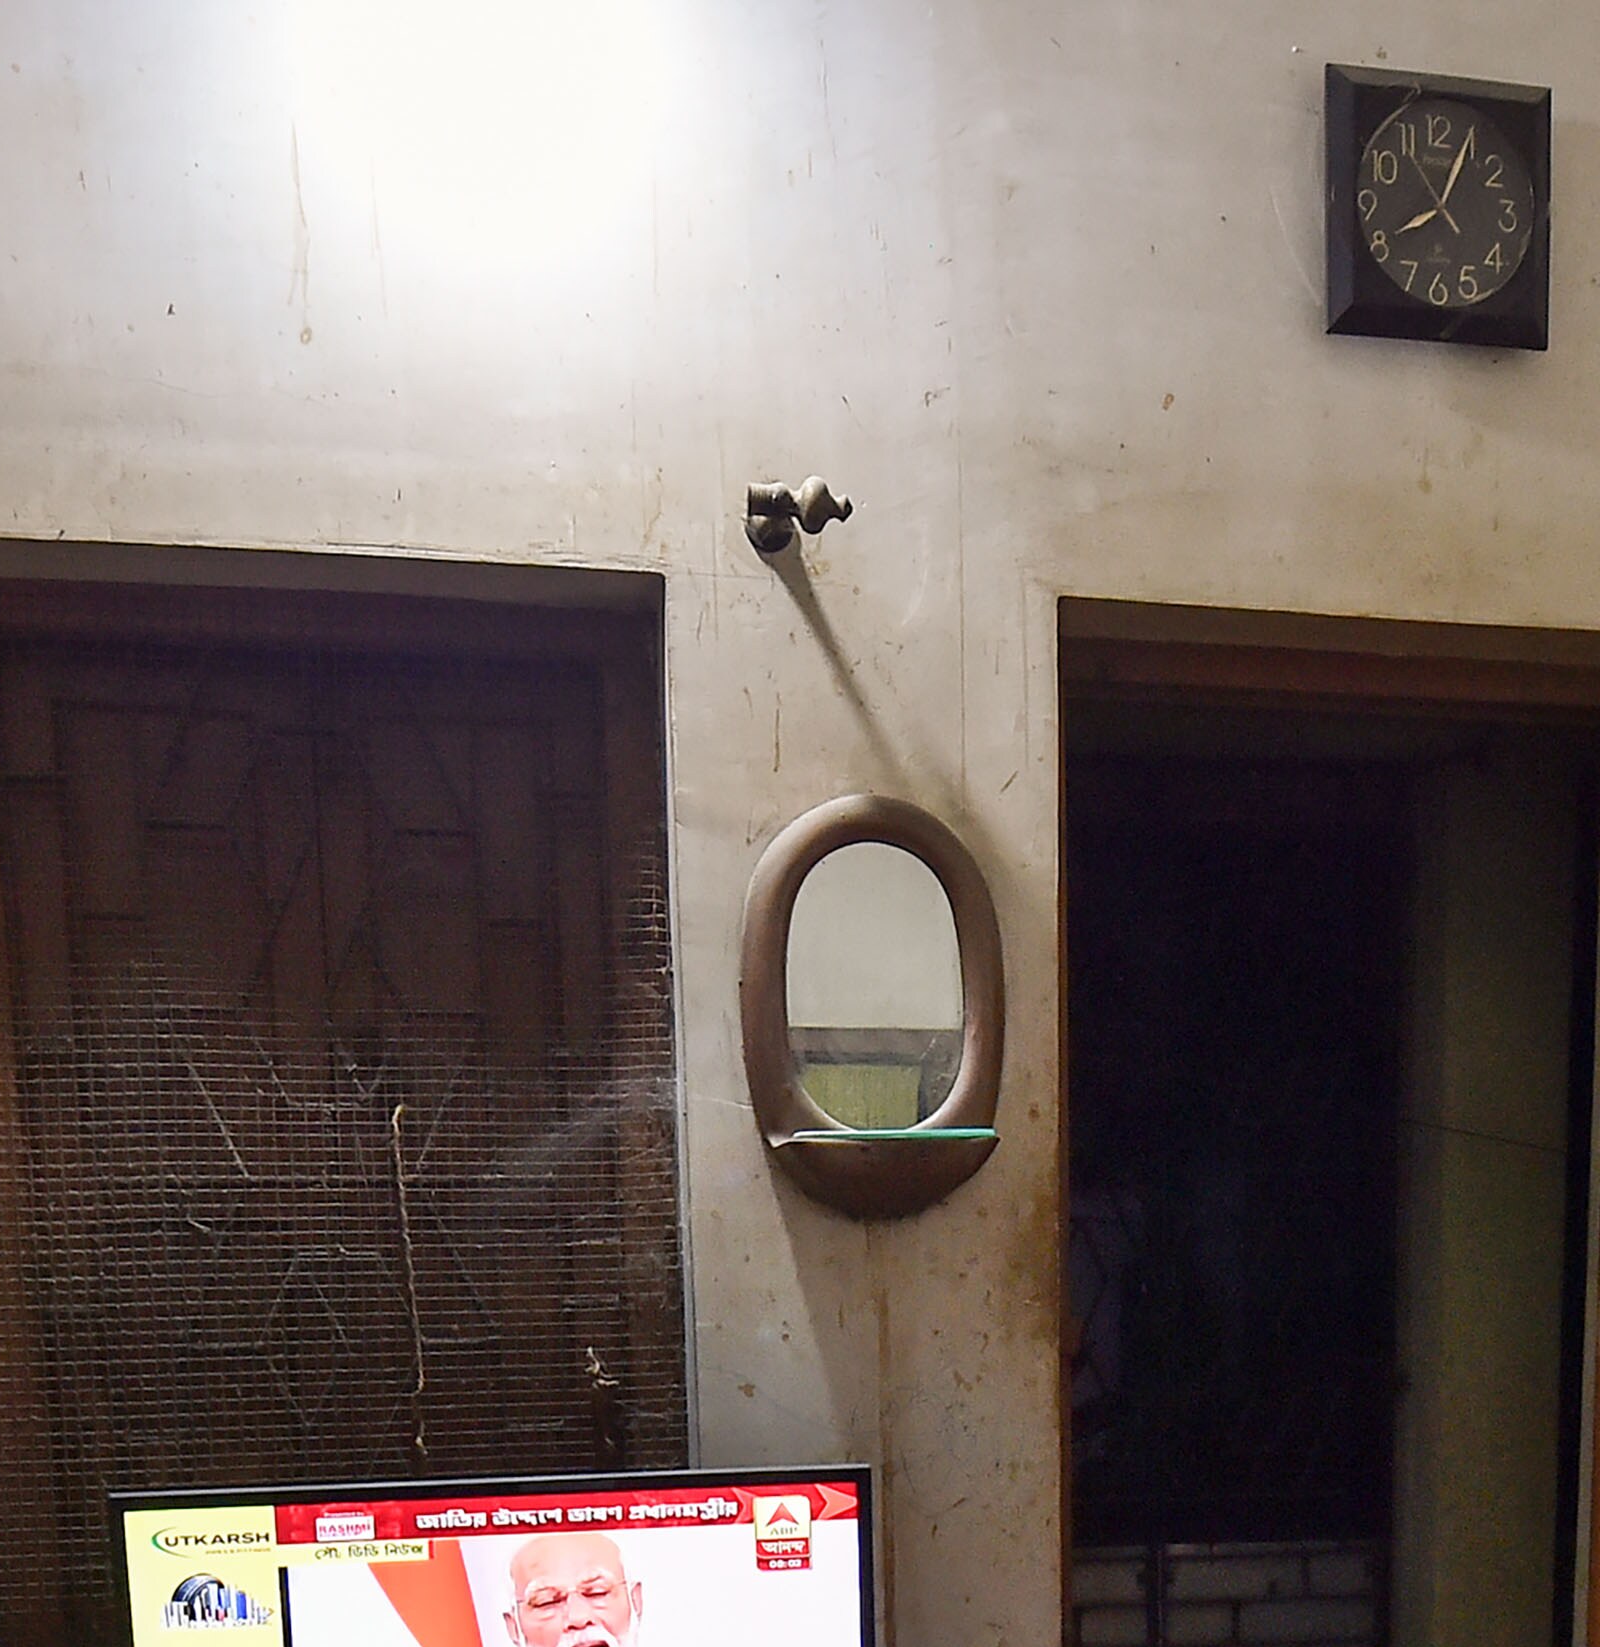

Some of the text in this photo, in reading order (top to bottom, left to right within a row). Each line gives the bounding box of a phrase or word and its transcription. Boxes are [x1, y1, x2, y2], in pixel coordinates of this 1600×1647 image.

[1395, 121, 1416, 157] 11
[1425, 114, 1451, 149] 12
[1372, 149, 1399, 185] 10
[1484, 154, 1504, 189] 2
[1357, 188, 1378, 221] 9
[1498, 199, 1518, 233] 3
[1370, 229, 1390, 263] 8
[1483, 242, 1502, 275] 4
[1400, 259, 1419, 292] 7
[1428, 272, 1449, 306] 6
[1457, 265, 1479, 299] 5
[415, 1508, 487, 1529] জাতির
[567, 1505, 623, 1523] ভাষণ
[164, 1532, 270, 1548] UTKARSH
